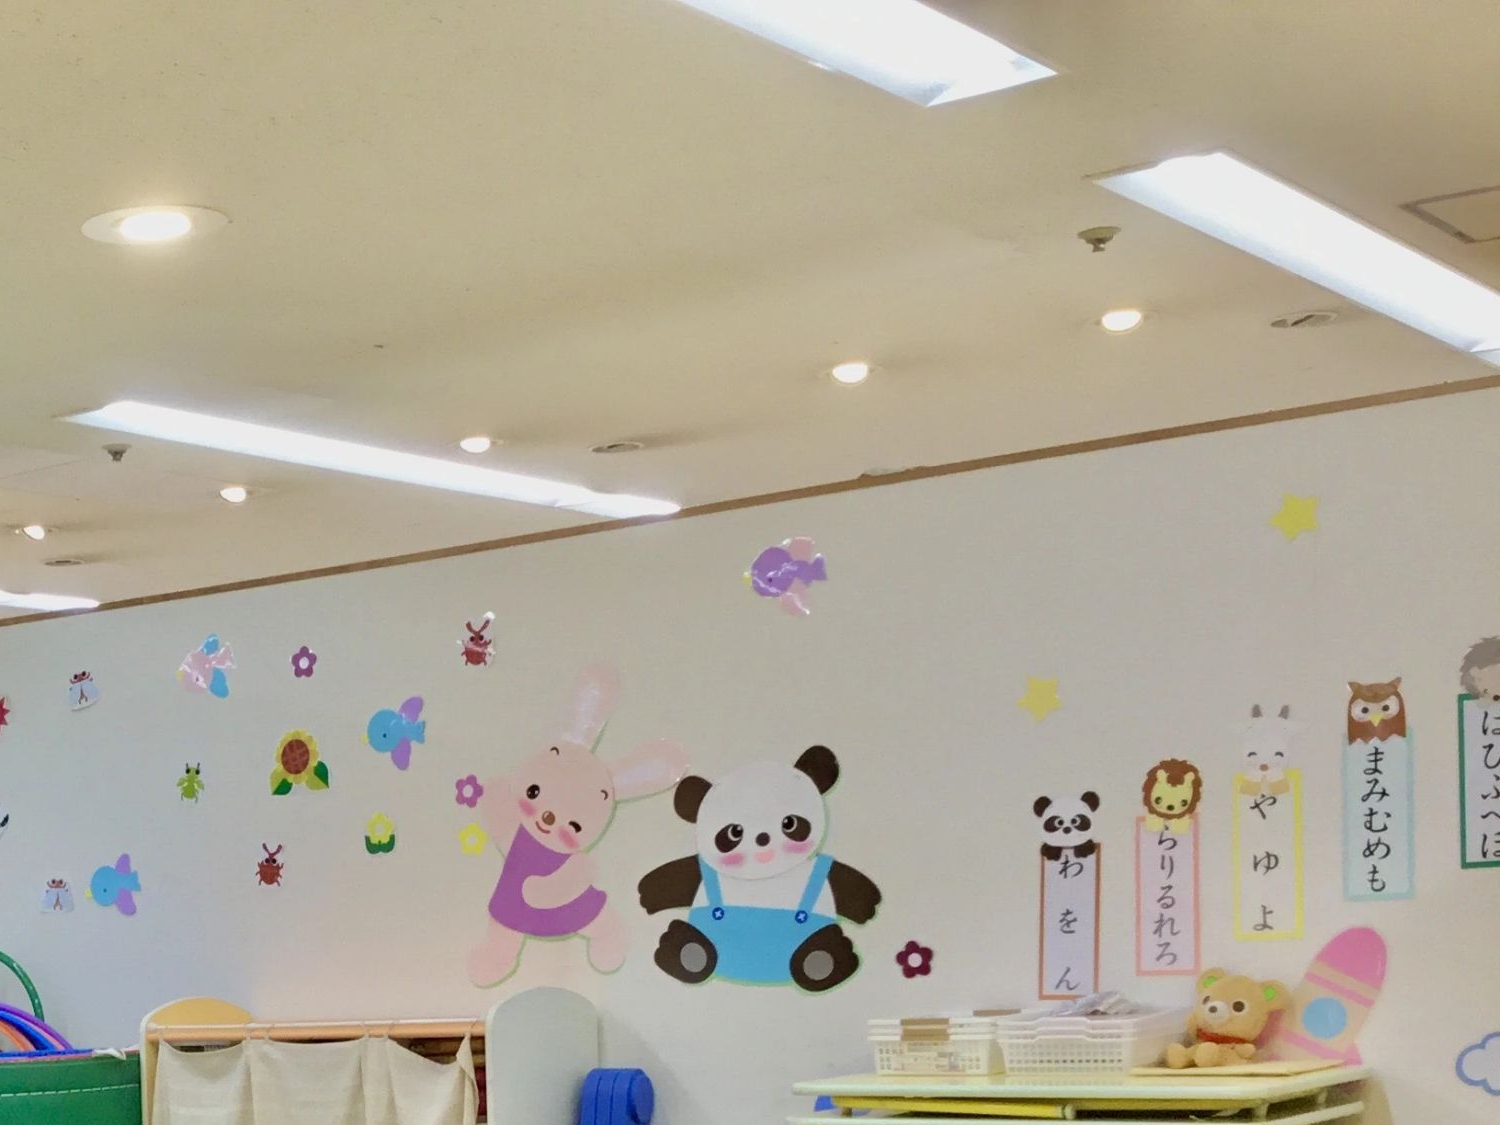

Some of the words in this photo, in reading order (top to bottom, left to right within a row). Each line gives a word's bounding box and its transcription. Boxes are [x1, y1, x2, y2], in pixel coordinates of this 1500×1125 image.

[1361, 746, 1392, 892] まみむめも
[1153, 824, 1181, 966] らりるれろ
